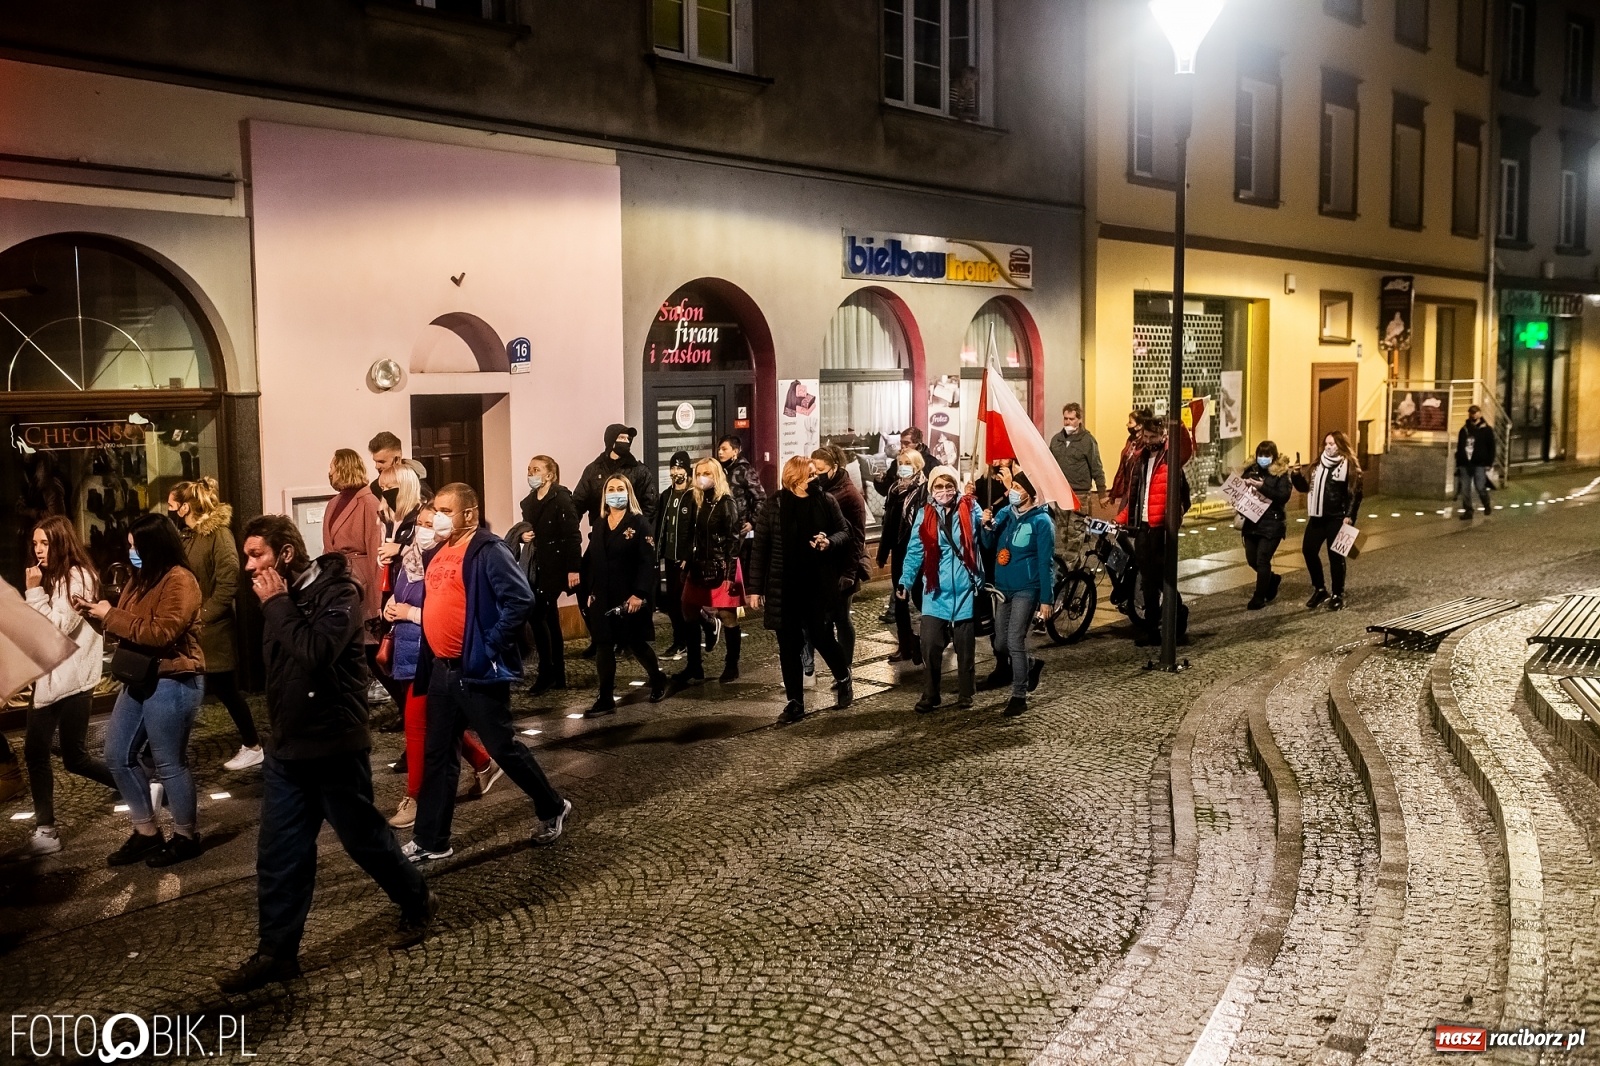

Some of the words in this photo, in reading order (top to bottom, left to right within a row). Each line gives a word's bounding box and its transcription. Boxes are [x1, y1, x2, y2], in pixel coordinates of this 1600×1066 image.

[848, 236, 946, 279] bielbaw
[946, 253, 1000, 282] home
[659, 298, 704, 321] Salon
[668, 317, 719, 353] firan
[515, 343, 528, 357] 16
[650, 343, 656, 363] i
[661, 341, 711, 364] zasłon
